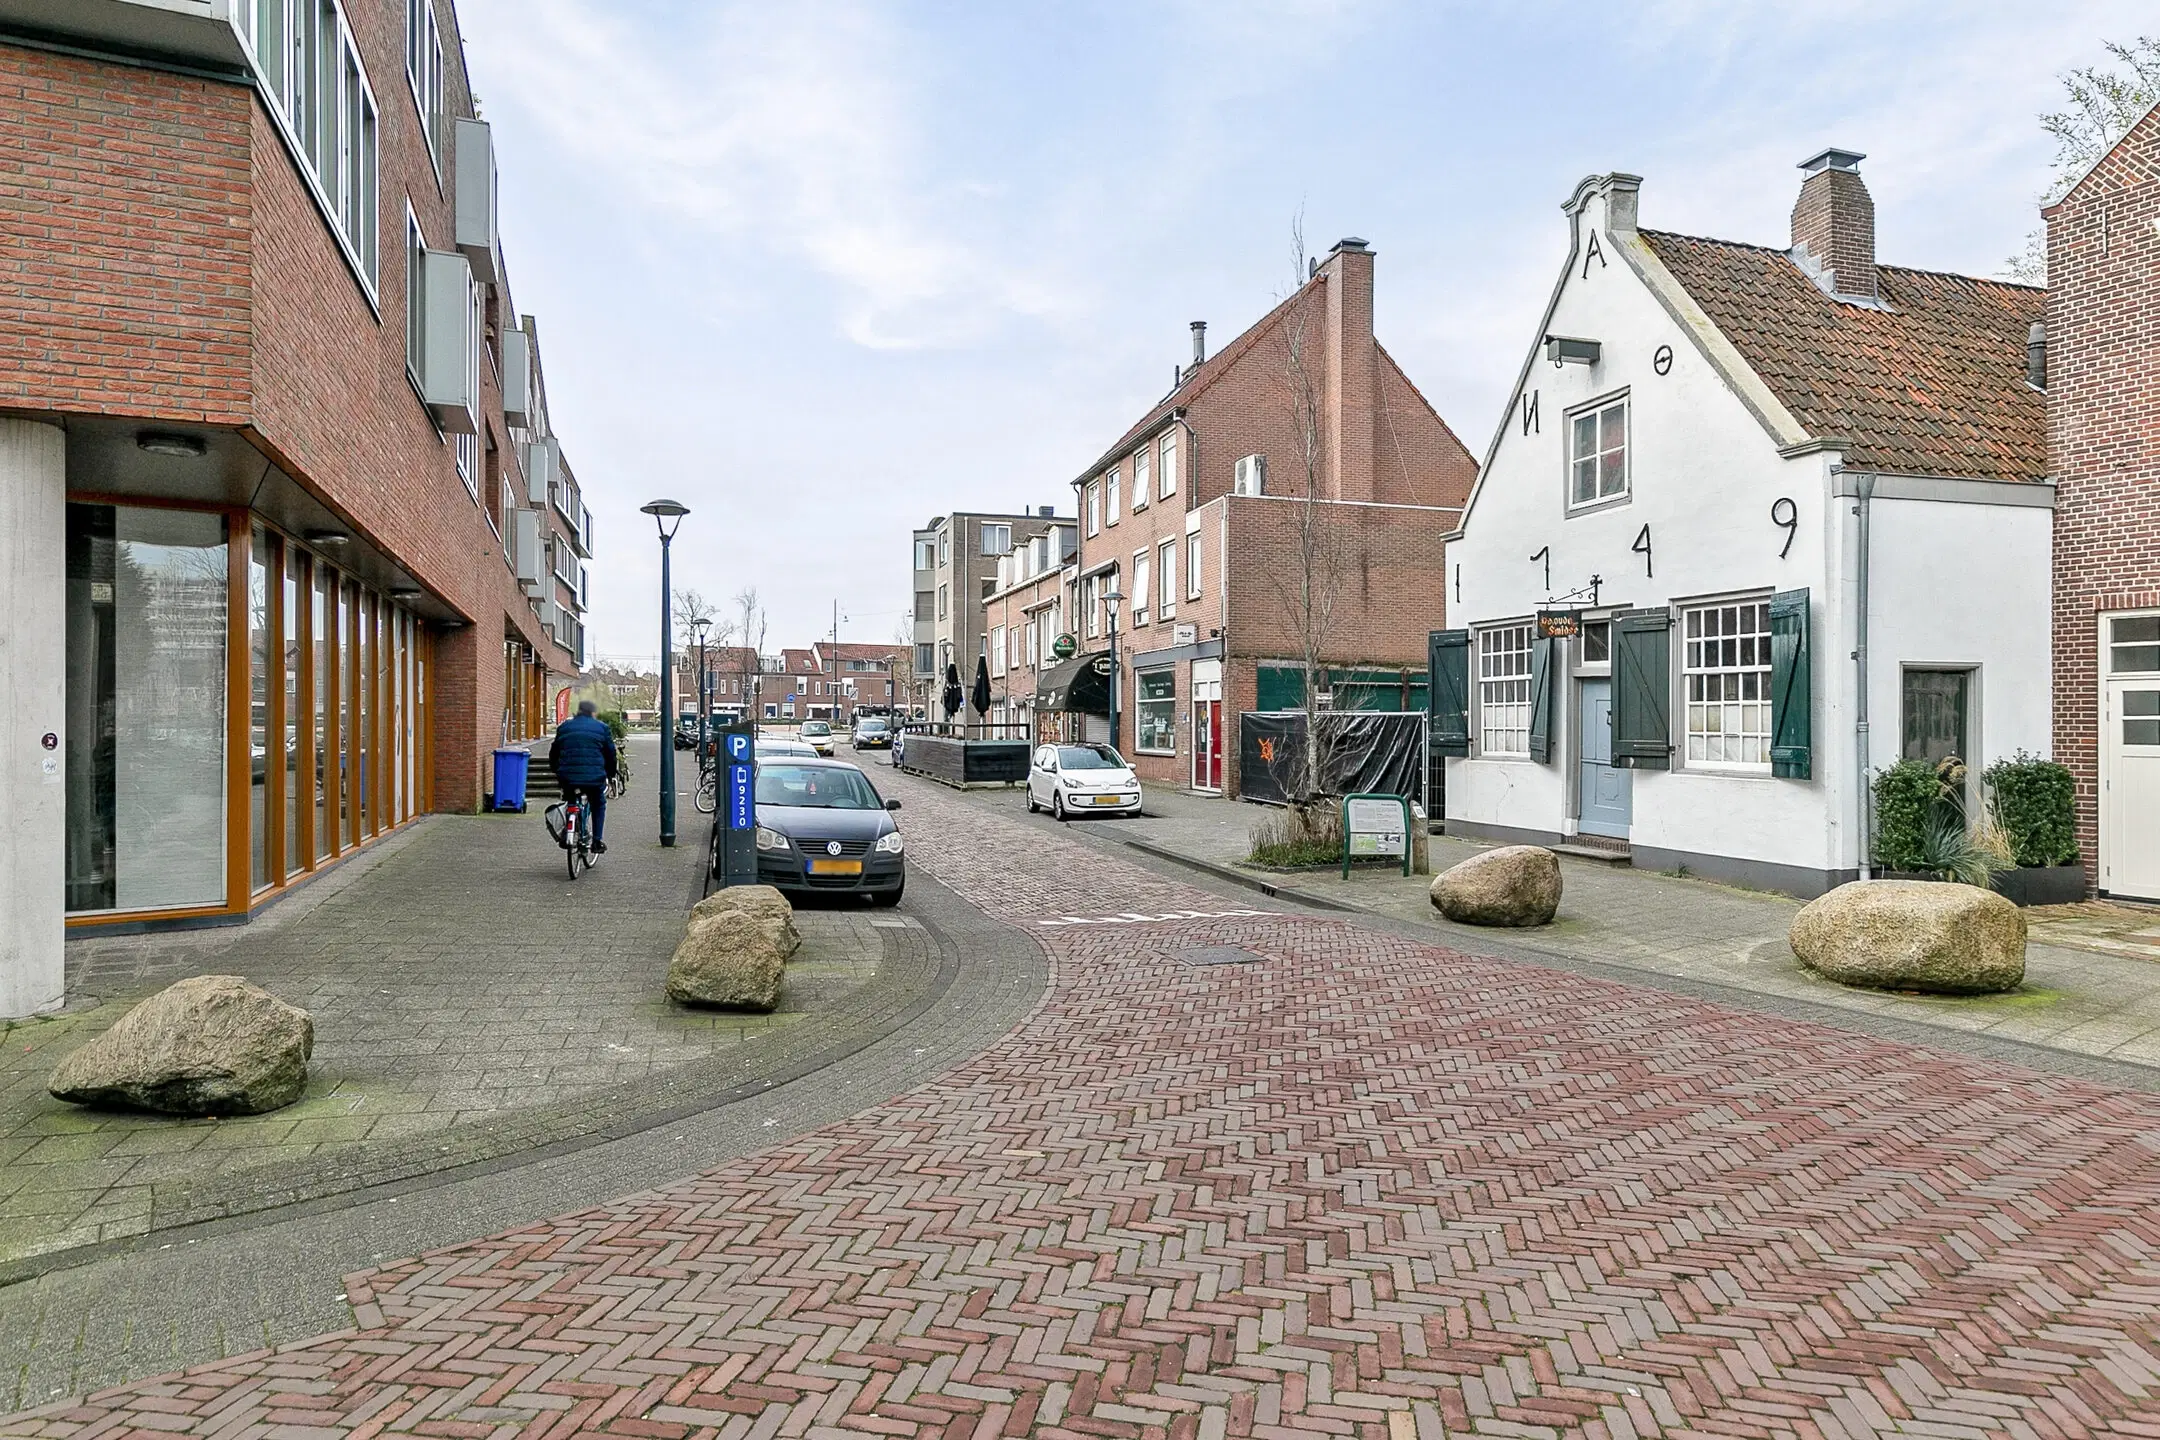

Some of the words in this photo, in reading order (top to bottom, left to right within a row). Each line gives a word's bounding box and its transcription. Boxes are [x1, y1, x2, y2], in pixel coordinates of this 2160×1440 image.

[1582, 228, 1607, 280] A
[1631, 522, 1653, 579] 4
[1771, 497, 1798, 560] 9
[733, 737, 747, 756] P
[738, 785, 746, 827] 9230
